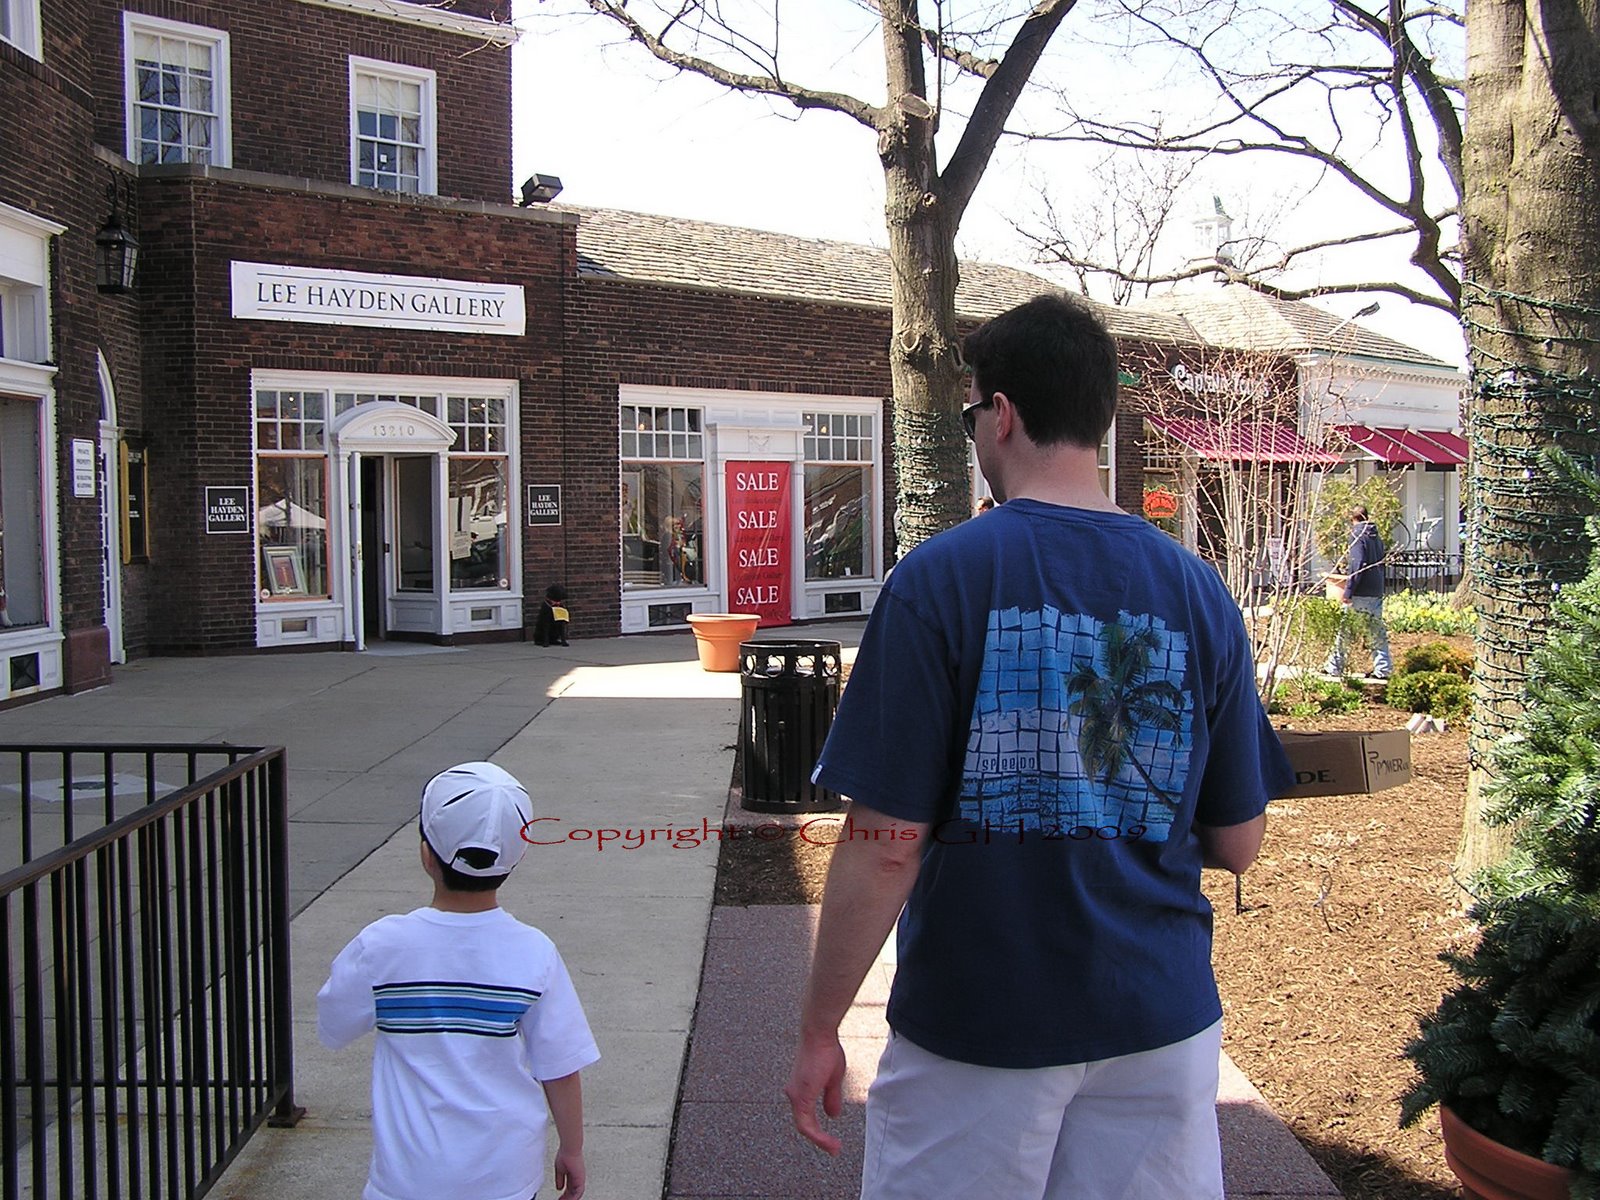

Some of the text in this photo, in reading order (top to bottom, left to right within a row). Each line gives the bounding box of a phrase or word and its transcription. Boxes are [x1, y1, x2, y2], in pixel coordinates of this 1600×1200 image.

[257, 282, 505, 319] LEE HAYDEN GALLERY
[373, 425, 415, 436] 13210
[736, 472, 779, 491] SALE
[738, 510, 777, 529] SALE
[739, 548, 779, 568] SALE
[736, 586, 779, 605] SALE
